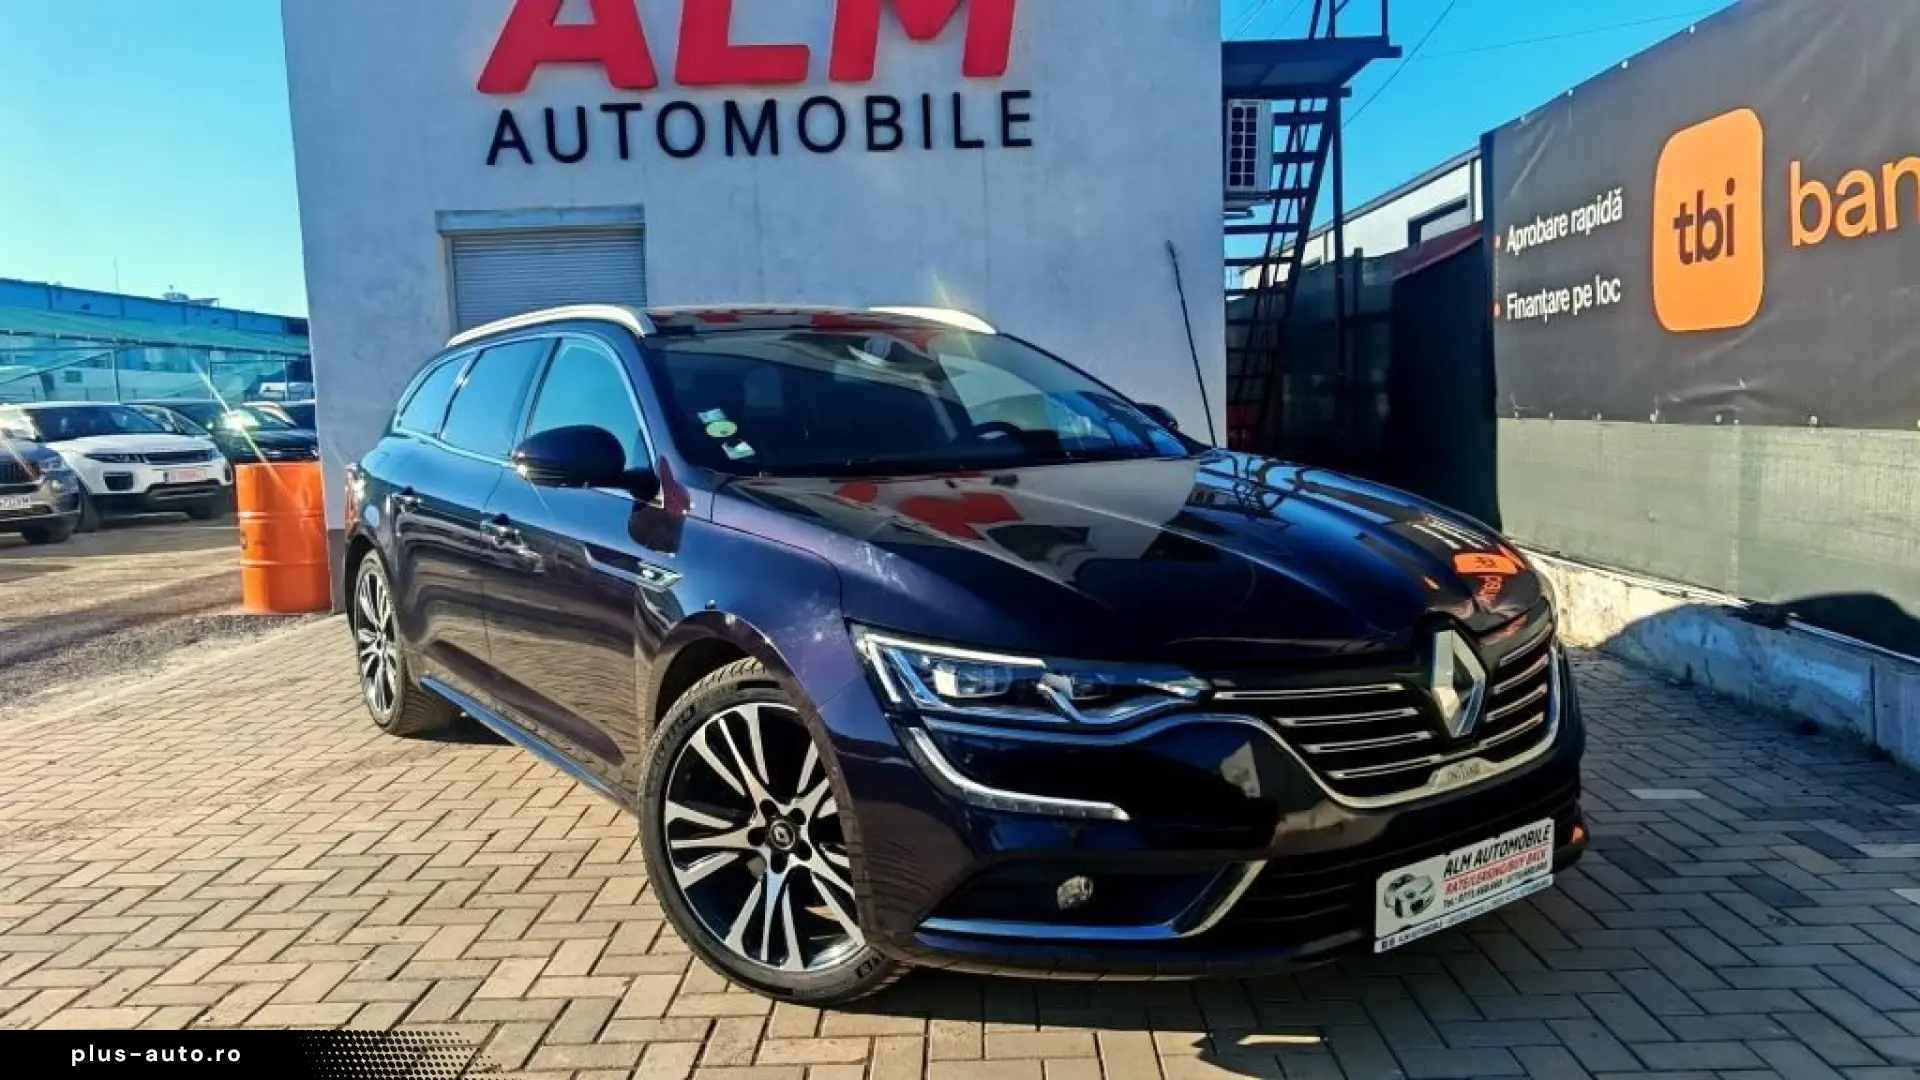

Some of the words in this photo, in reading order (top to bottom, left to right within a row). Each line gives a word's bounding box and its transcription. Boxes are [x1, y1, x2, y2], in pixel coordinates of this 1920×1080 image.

[486, 89, 1033, 166] AUTOMOBILE
[1506, 212, 1569, 256] Aprobare
[1570, 187, 1623, 237] rapidă
[1673, 177, 1736, 266] tbi
[1573, 283, 1593, 314] pe
[1596, 275, 1621, 305] loc
[1443, 852, 1472, 878] ALM
[1474, 824, 1552, 867] AUTOMOBILE
